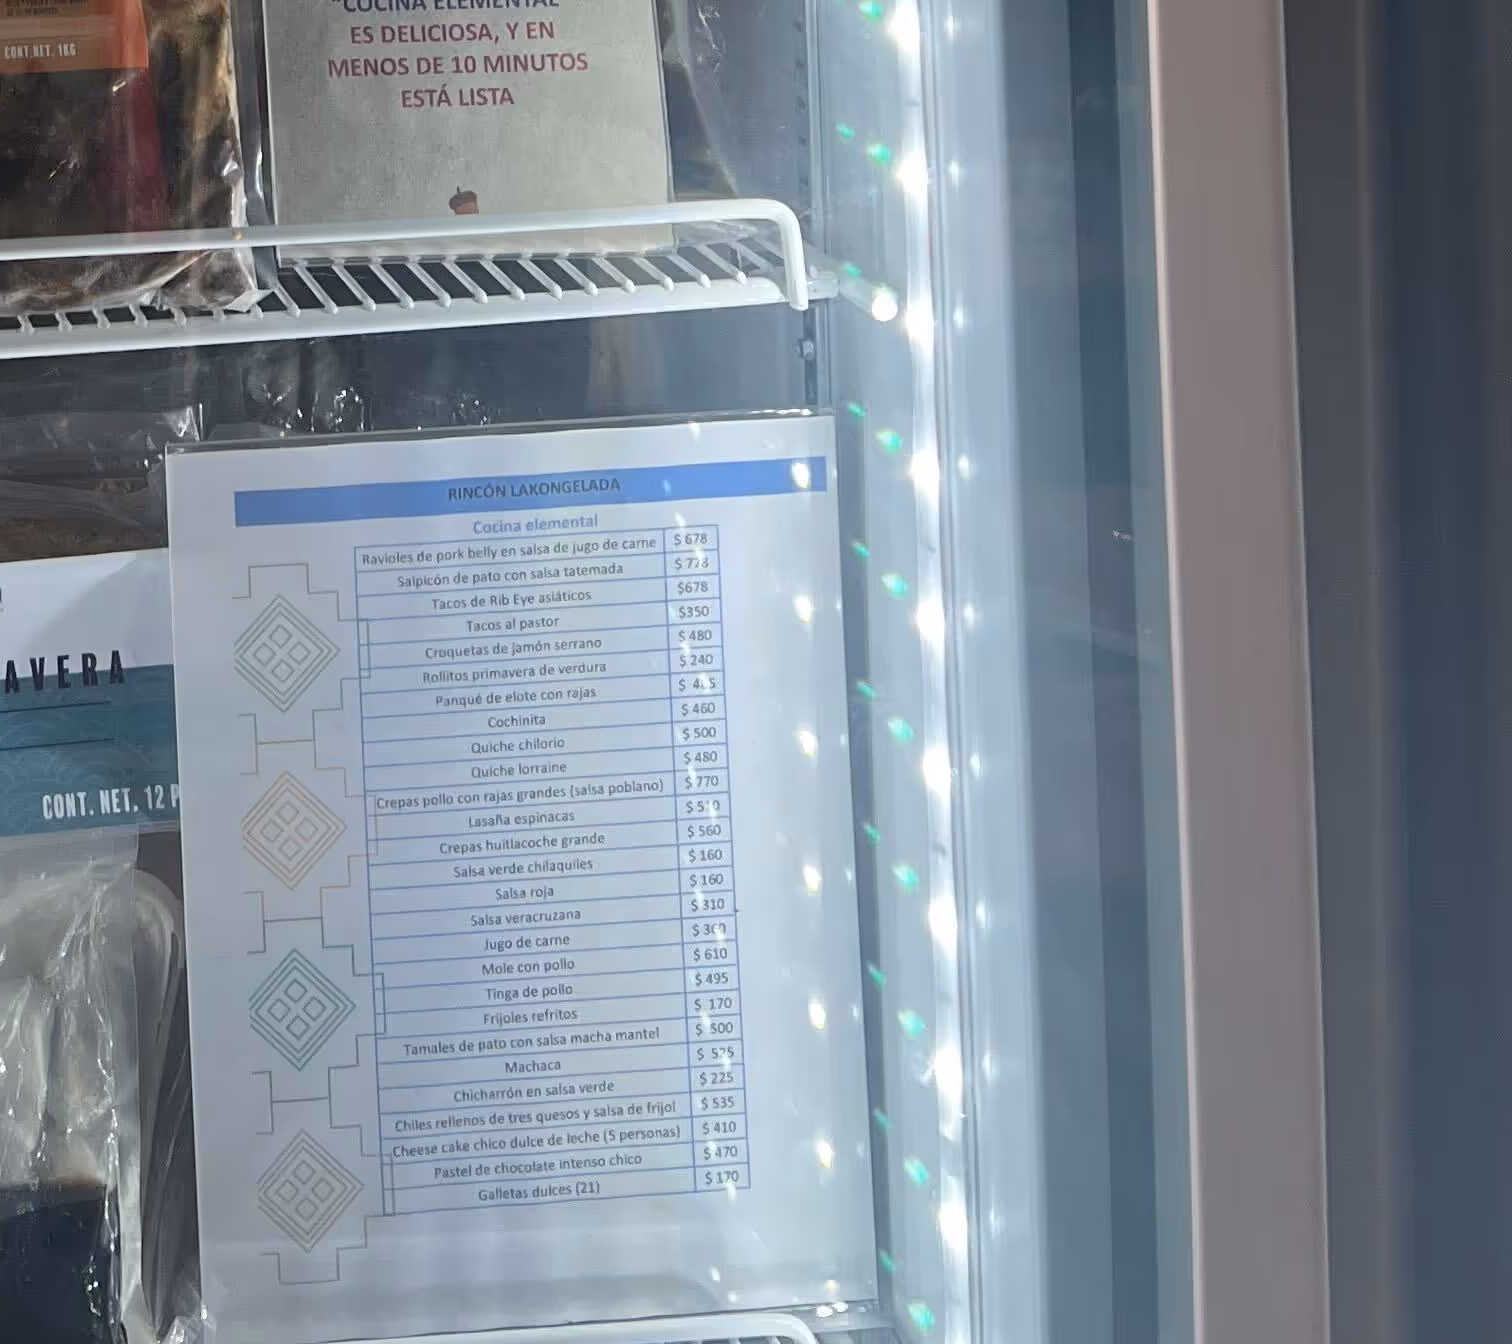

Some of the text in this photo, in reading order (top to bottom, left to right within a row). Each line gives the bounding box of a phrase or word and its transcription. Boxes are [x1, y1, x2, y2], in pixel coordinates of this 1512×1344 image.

[350, 21, 555, 44] ES DELICIOSA, Y EN
[328, 52, 588, 77] MENOS DE 10 MINUTOS
[401, 84, 515, 108] ESTÁ LISTA
[448, 477, 620, 500] RINCÓN LAKONGELADA
[471, 512, 598, 535] Cocina elemental
[362, 538, 656, 565] Ravioles de pork belly en salsa de jugo de carne
[397, 561, 623, 589] Salpicón de pato con salsa tatemada
[431, 580, 708, 610] Tacos de Rib Eye asiáticos $678
[466, 604, 710, 632] Tacos al pastor $350
[424, 638, 602, 661] Croquetas de jamón serrano
[422, 660, 606, 683] Rollitos primavera de verdura
[435, 686, 597, 709] Panqué de elote con rajas
[487, 712, 546, 728] Cochinita
[470, 736, 565, 754] Quiche chilorio
[471, 760, 567, 779] Quiche lorraine
[42, 791, 94, 820] CONT.
[99, 787, 139, 814] NET.
[144, 784, 165, 810] 12
[376, 778, 664, 812] Crepas pollo con rajas grandes (salsa poblano)
[468, 809, 575, 828] Lasaña espinacas
[439, 831, 605, 857] Crepas huitlacoche grande
[453, 856, 593, 878] Salsa verde chilaquiles
[495, 885, 554, 900] Salsa roja
[470, 910, 581, 928] Salsa veracruzana
[483, 935, 570, 953] Jugo de carne
[481, 956, 575, 975] Mole con pollo
[484, 982, 573, 1003] Tinga de pollo
[483, 1006, 578, 1028] Frijoles refritos
[403, 1026, 660, 1056] Tamales de pato con salsa macha mantel
[504, 1058, 561, 1074] Machaca
[453, 1079, 615, 1103] Chicharrón en salsa verde
[394, 1118, 432, 1132] Chiles
[435, 1113, 485, 1128] rellenos
[488, 1112, 505, 1125] de
[507, 1111, 533, 1124] tres
[535, 1109, 580, 1125] quesos
[592, 1103, 624, 1117] salsa
[627, 1102, 643, 1115] de
[646, 1100, 676, 1117] frijol
[391, 1124, 680, 1158] Cheese cake chico dulce de leche (5 personas)
[434, 1150, 642, 1179] Pastel de chocolate intenso chico
[477, 1179, 600, 1201] Galletas dulces (21)
